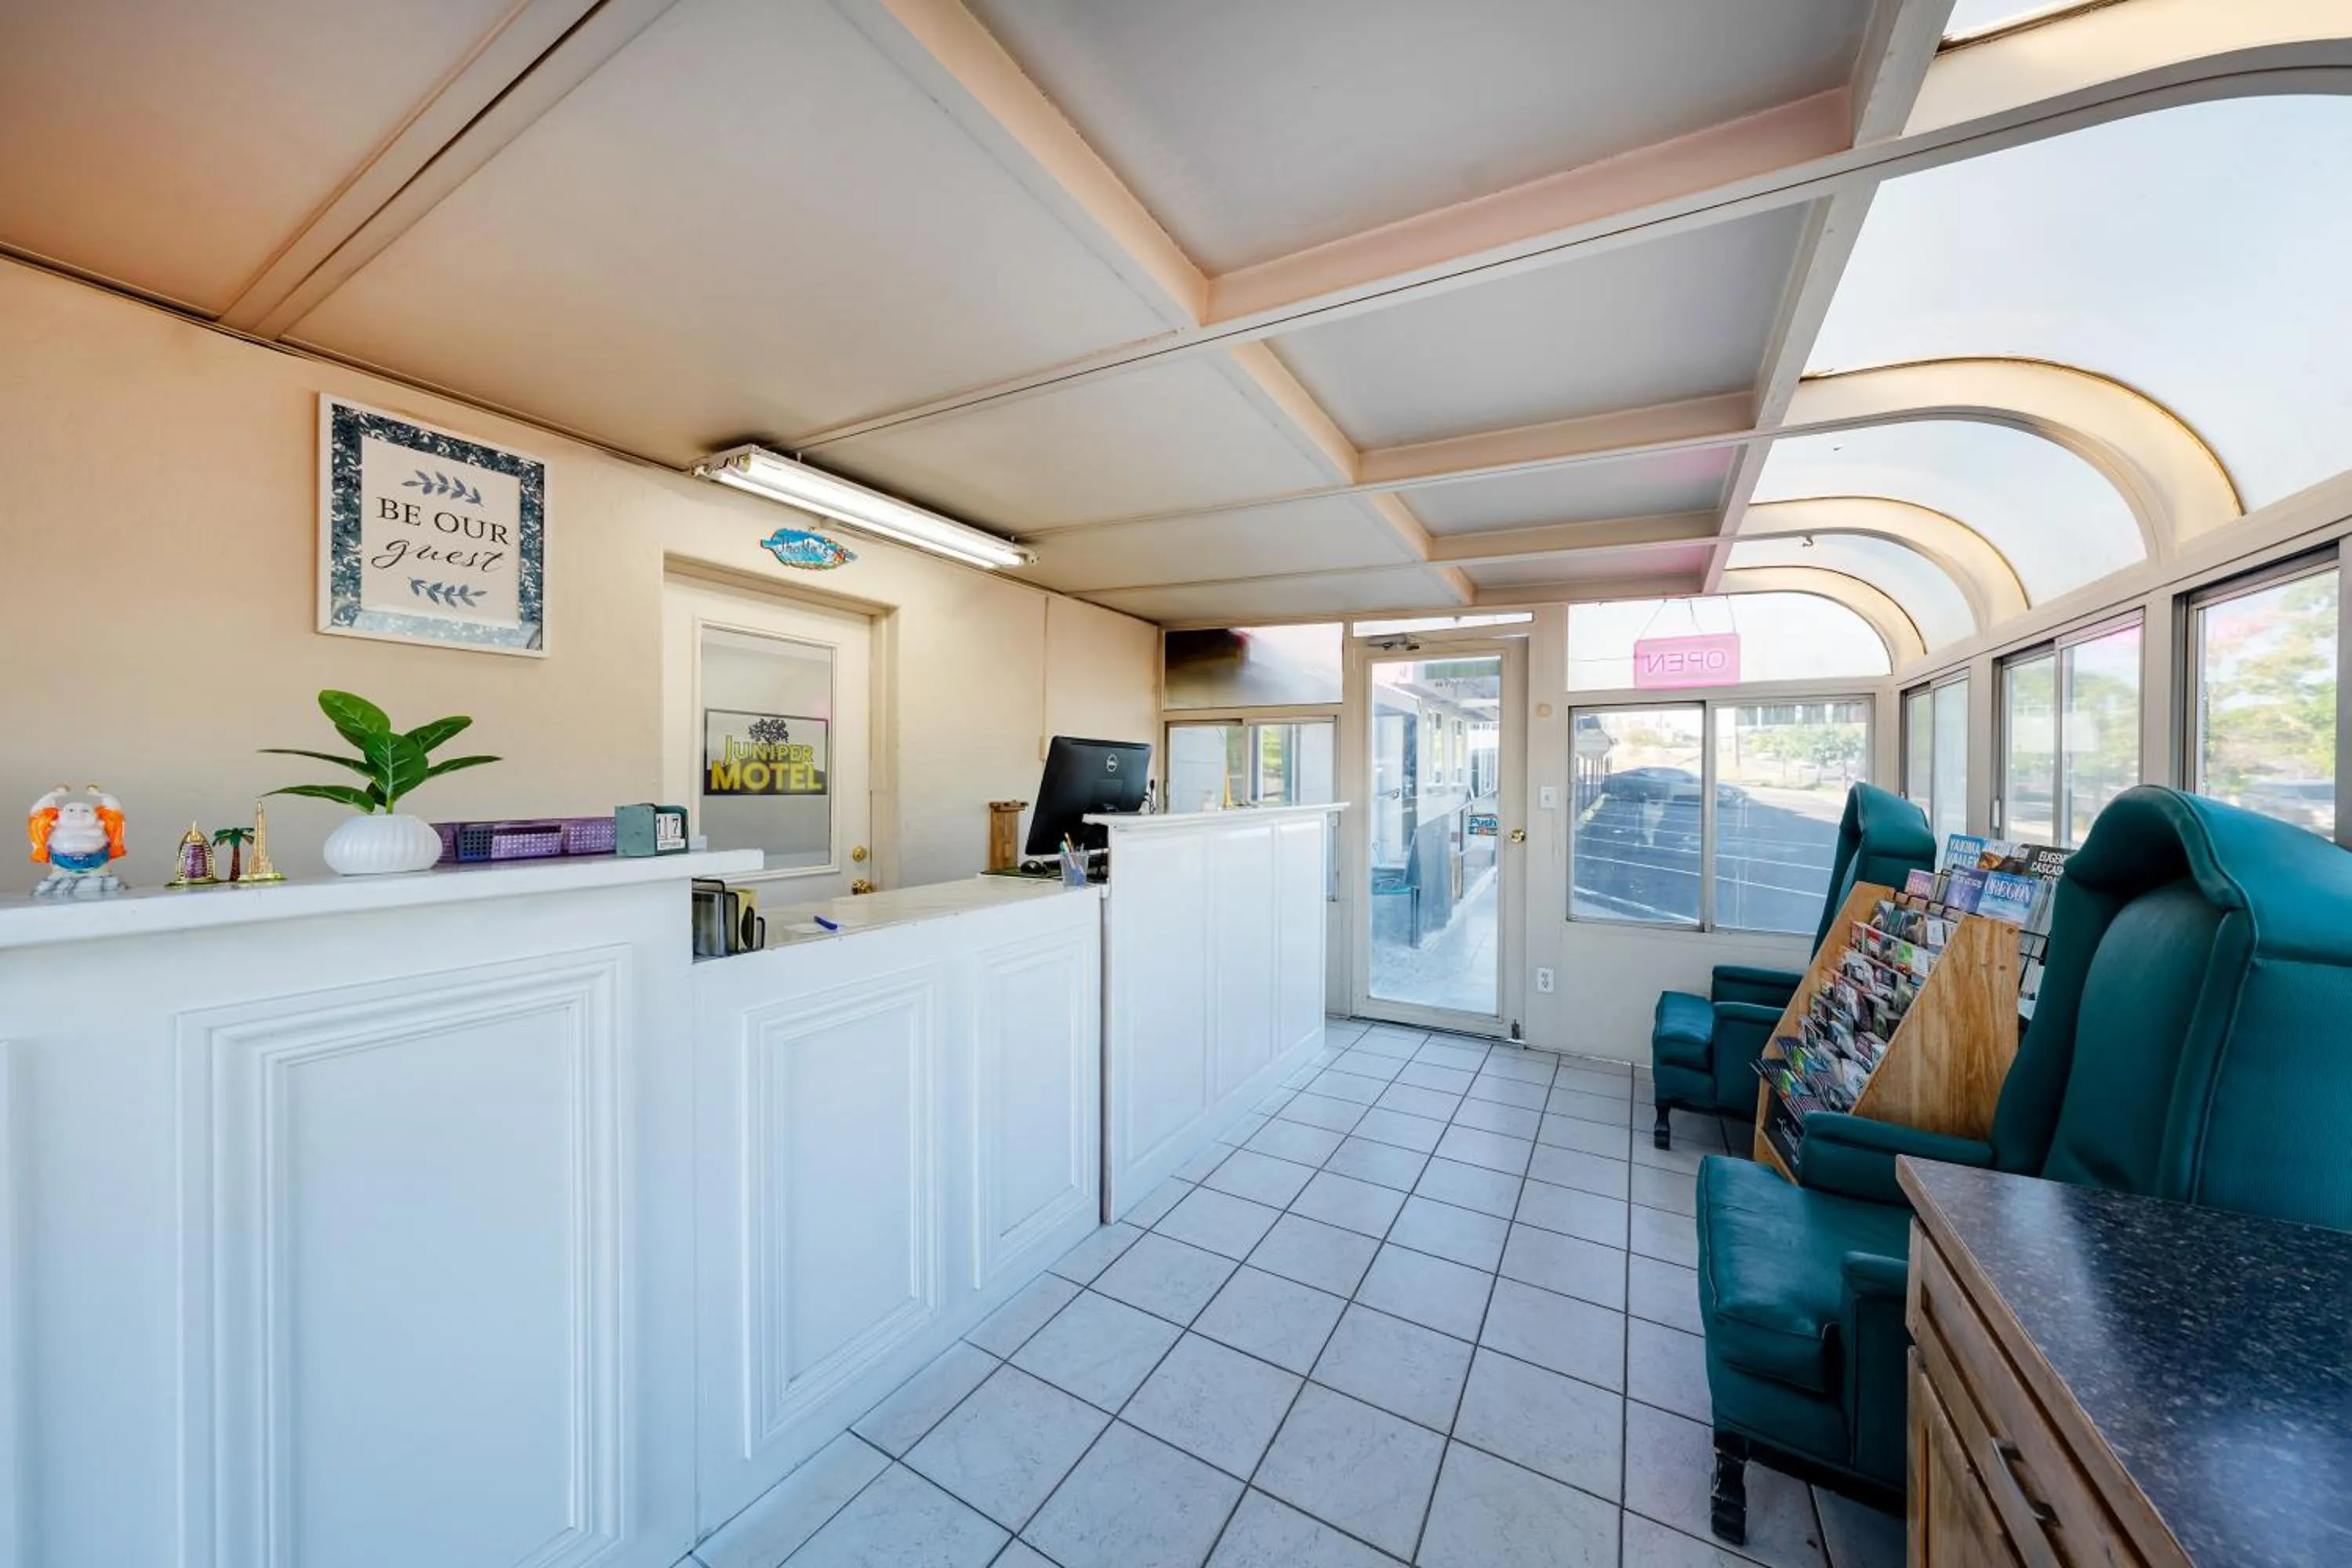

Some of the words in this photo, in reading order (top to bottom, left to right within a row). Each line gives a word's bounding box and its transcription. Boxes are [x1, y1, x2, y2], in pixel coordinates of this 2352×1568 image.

[376, 496, 421, 527] BE
[434, 512, 511, 546] OUR
[371, 539, 505, 573] guest
[724, 735, 814, 766] JUNIPER
[711, 759, 822, 791] MOTEL
